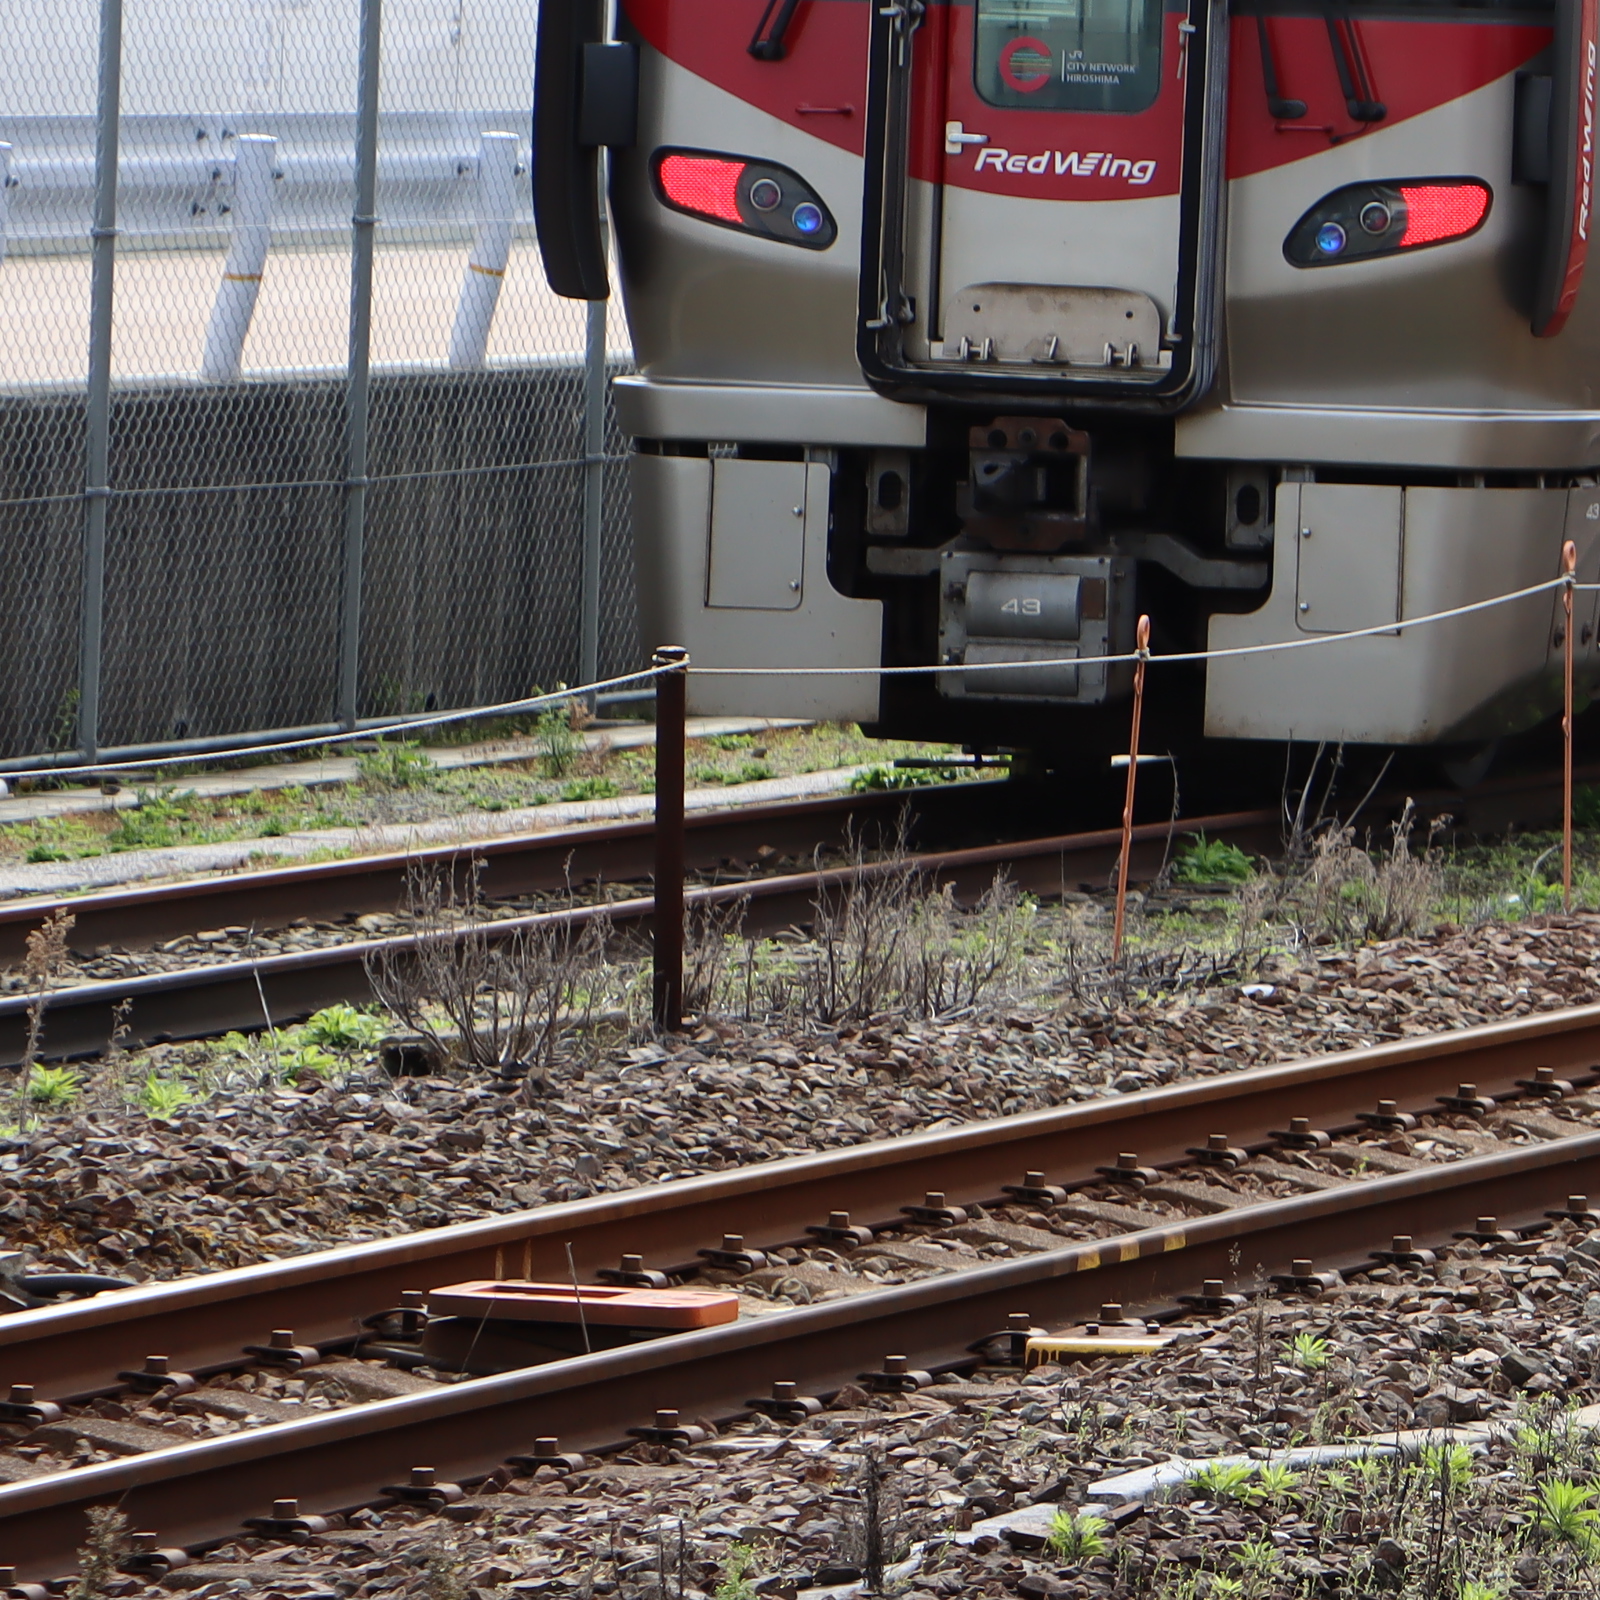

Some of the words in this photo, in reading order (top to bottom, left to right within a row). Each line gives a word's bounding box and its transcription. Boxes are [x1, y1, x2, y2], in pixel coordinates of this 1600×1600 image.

[1068, 50, 1083, 60] JR
[1066, 61, 1087, 72] CITY
[1089, 62, 1136, 75] NETWORK
[1066, 73, 1120, 85] HIROSHIMA
[1585, 502, 1600, 520] 43
[1000, 598, 1042, 616] 43
